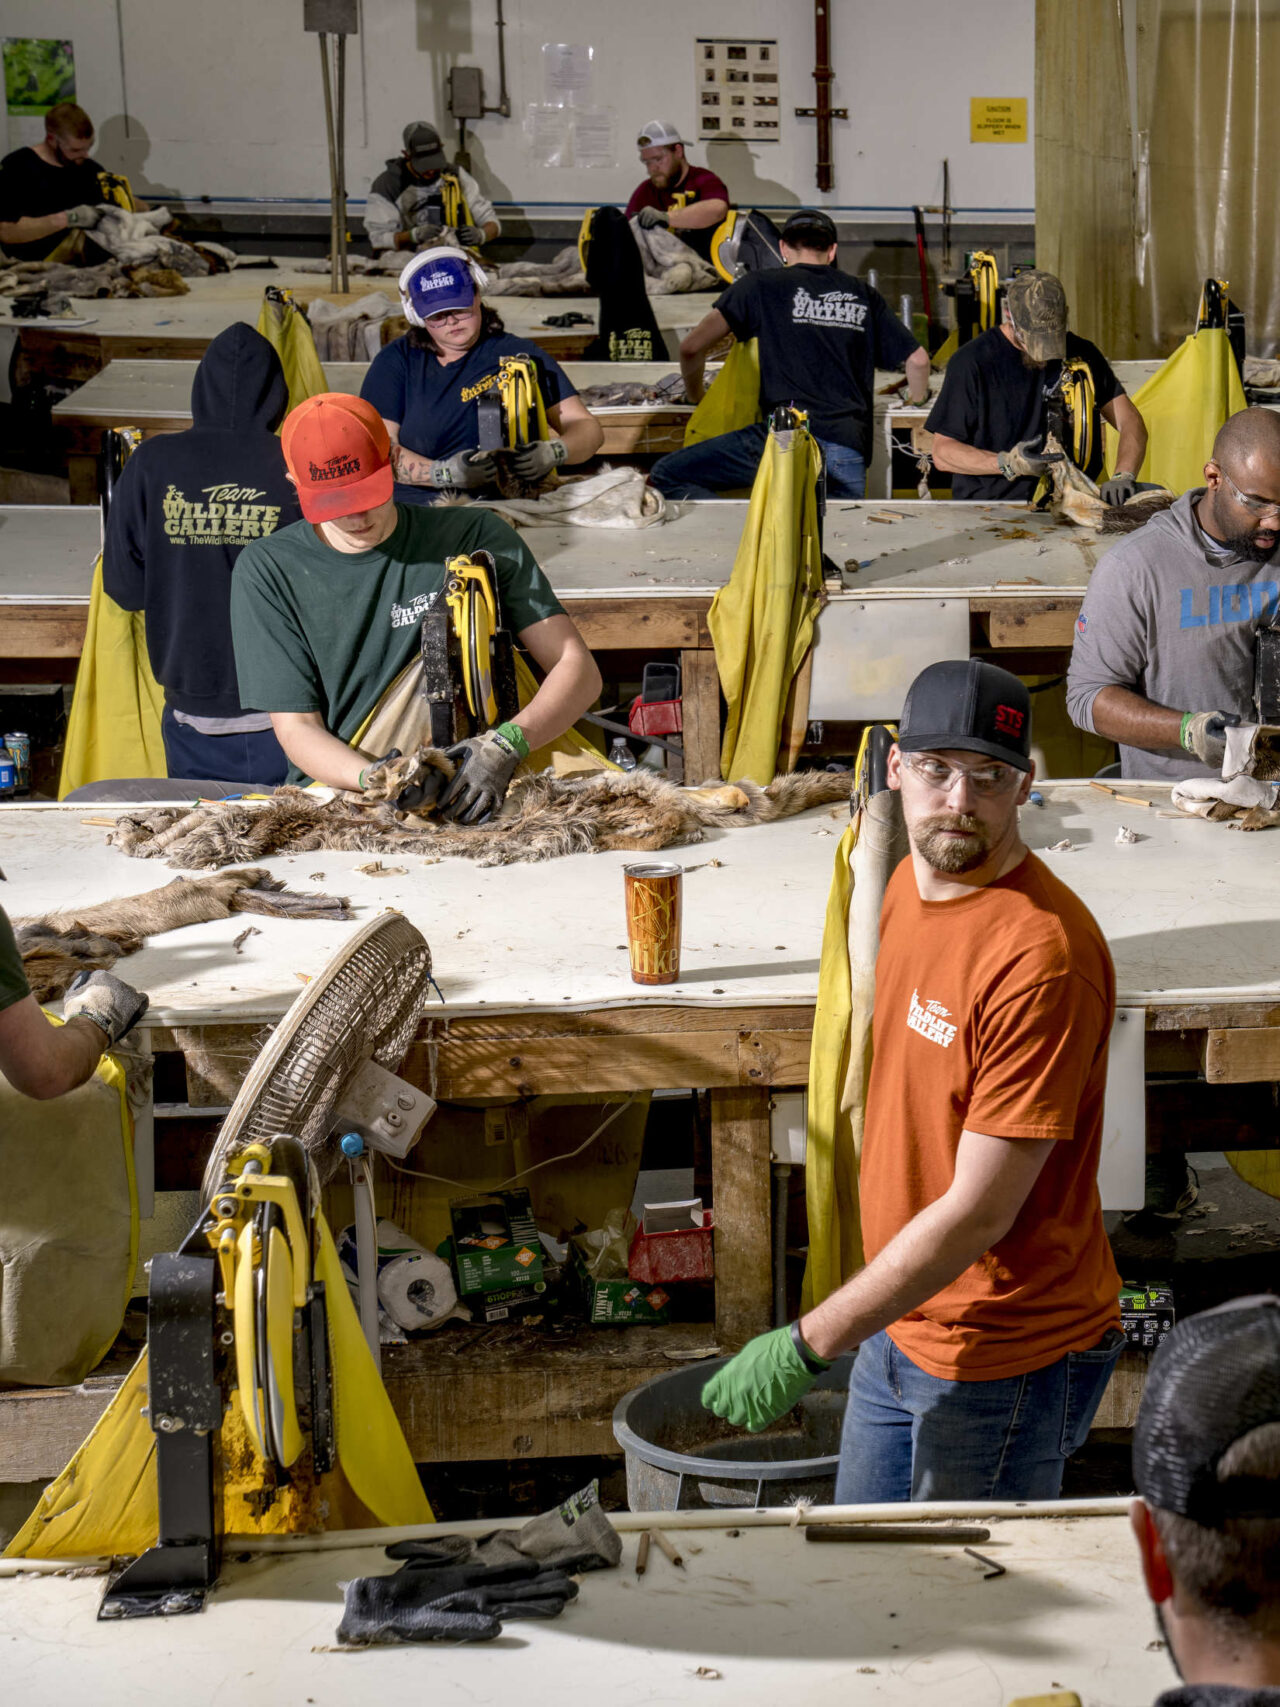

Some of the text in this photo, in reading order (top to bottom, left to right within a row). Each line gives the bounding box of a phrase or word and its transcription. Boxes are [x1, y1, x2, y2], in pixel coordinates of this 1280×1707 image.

[818, 291, 858, 302] Team
[793, 298, 868, 315] WILDLIFE
[792, 307, 867, 325] GALLERY
[201, 483, 267, 503] Team
[163, 500, 281, 522] WILDLIFE
[164, 519, 278, 537] GALLERY
[996, 704, 1024, 729] STS
[926, 1000, 952, 1018] Team
[595, 1287, 609, 1317] VINYL
